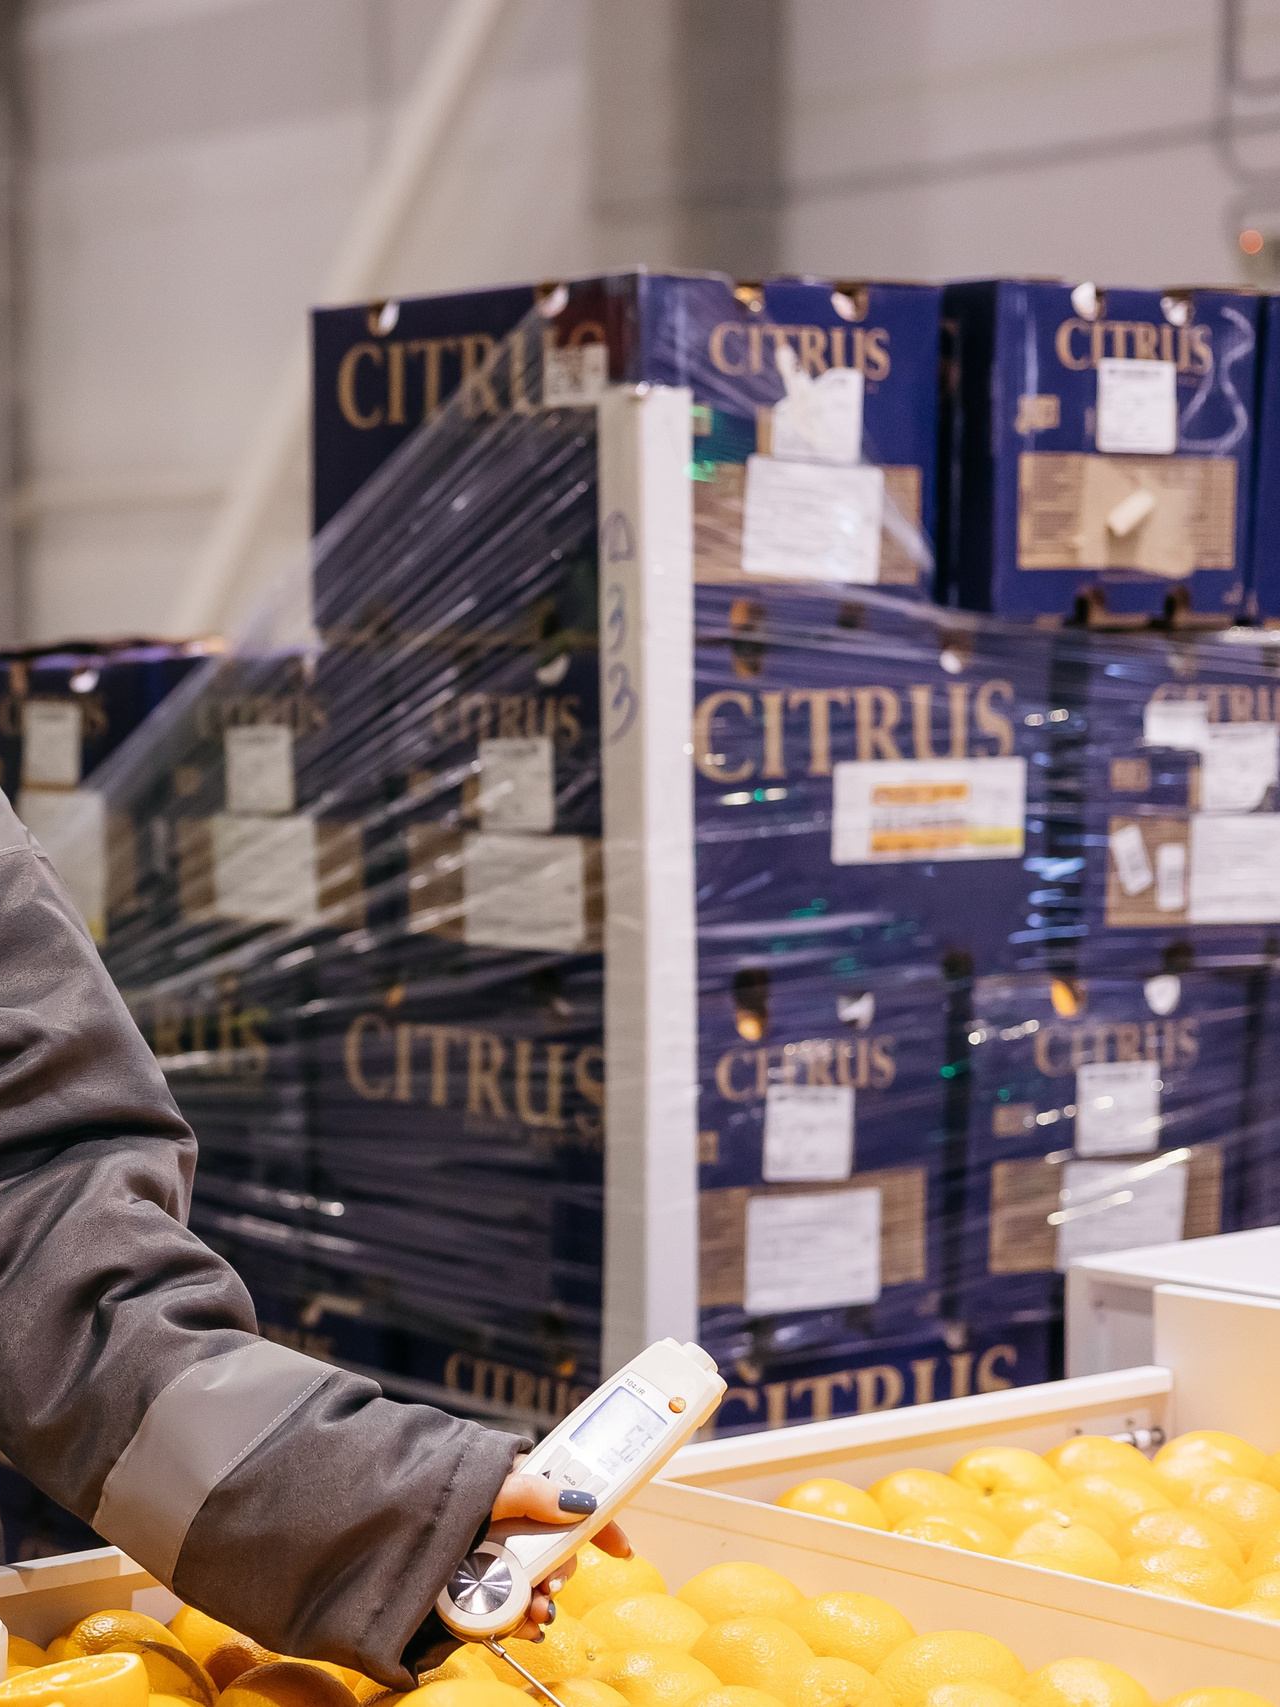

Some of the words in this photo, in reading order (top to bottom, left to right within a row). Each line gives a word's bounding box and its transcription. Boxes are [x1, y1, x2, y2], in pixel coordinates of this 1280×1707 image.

[709, 321, 891, 382] CITRUS
[692, 680, 1015, 783] CITRUS
[624, 1377, 646, 1396] 104-IR
